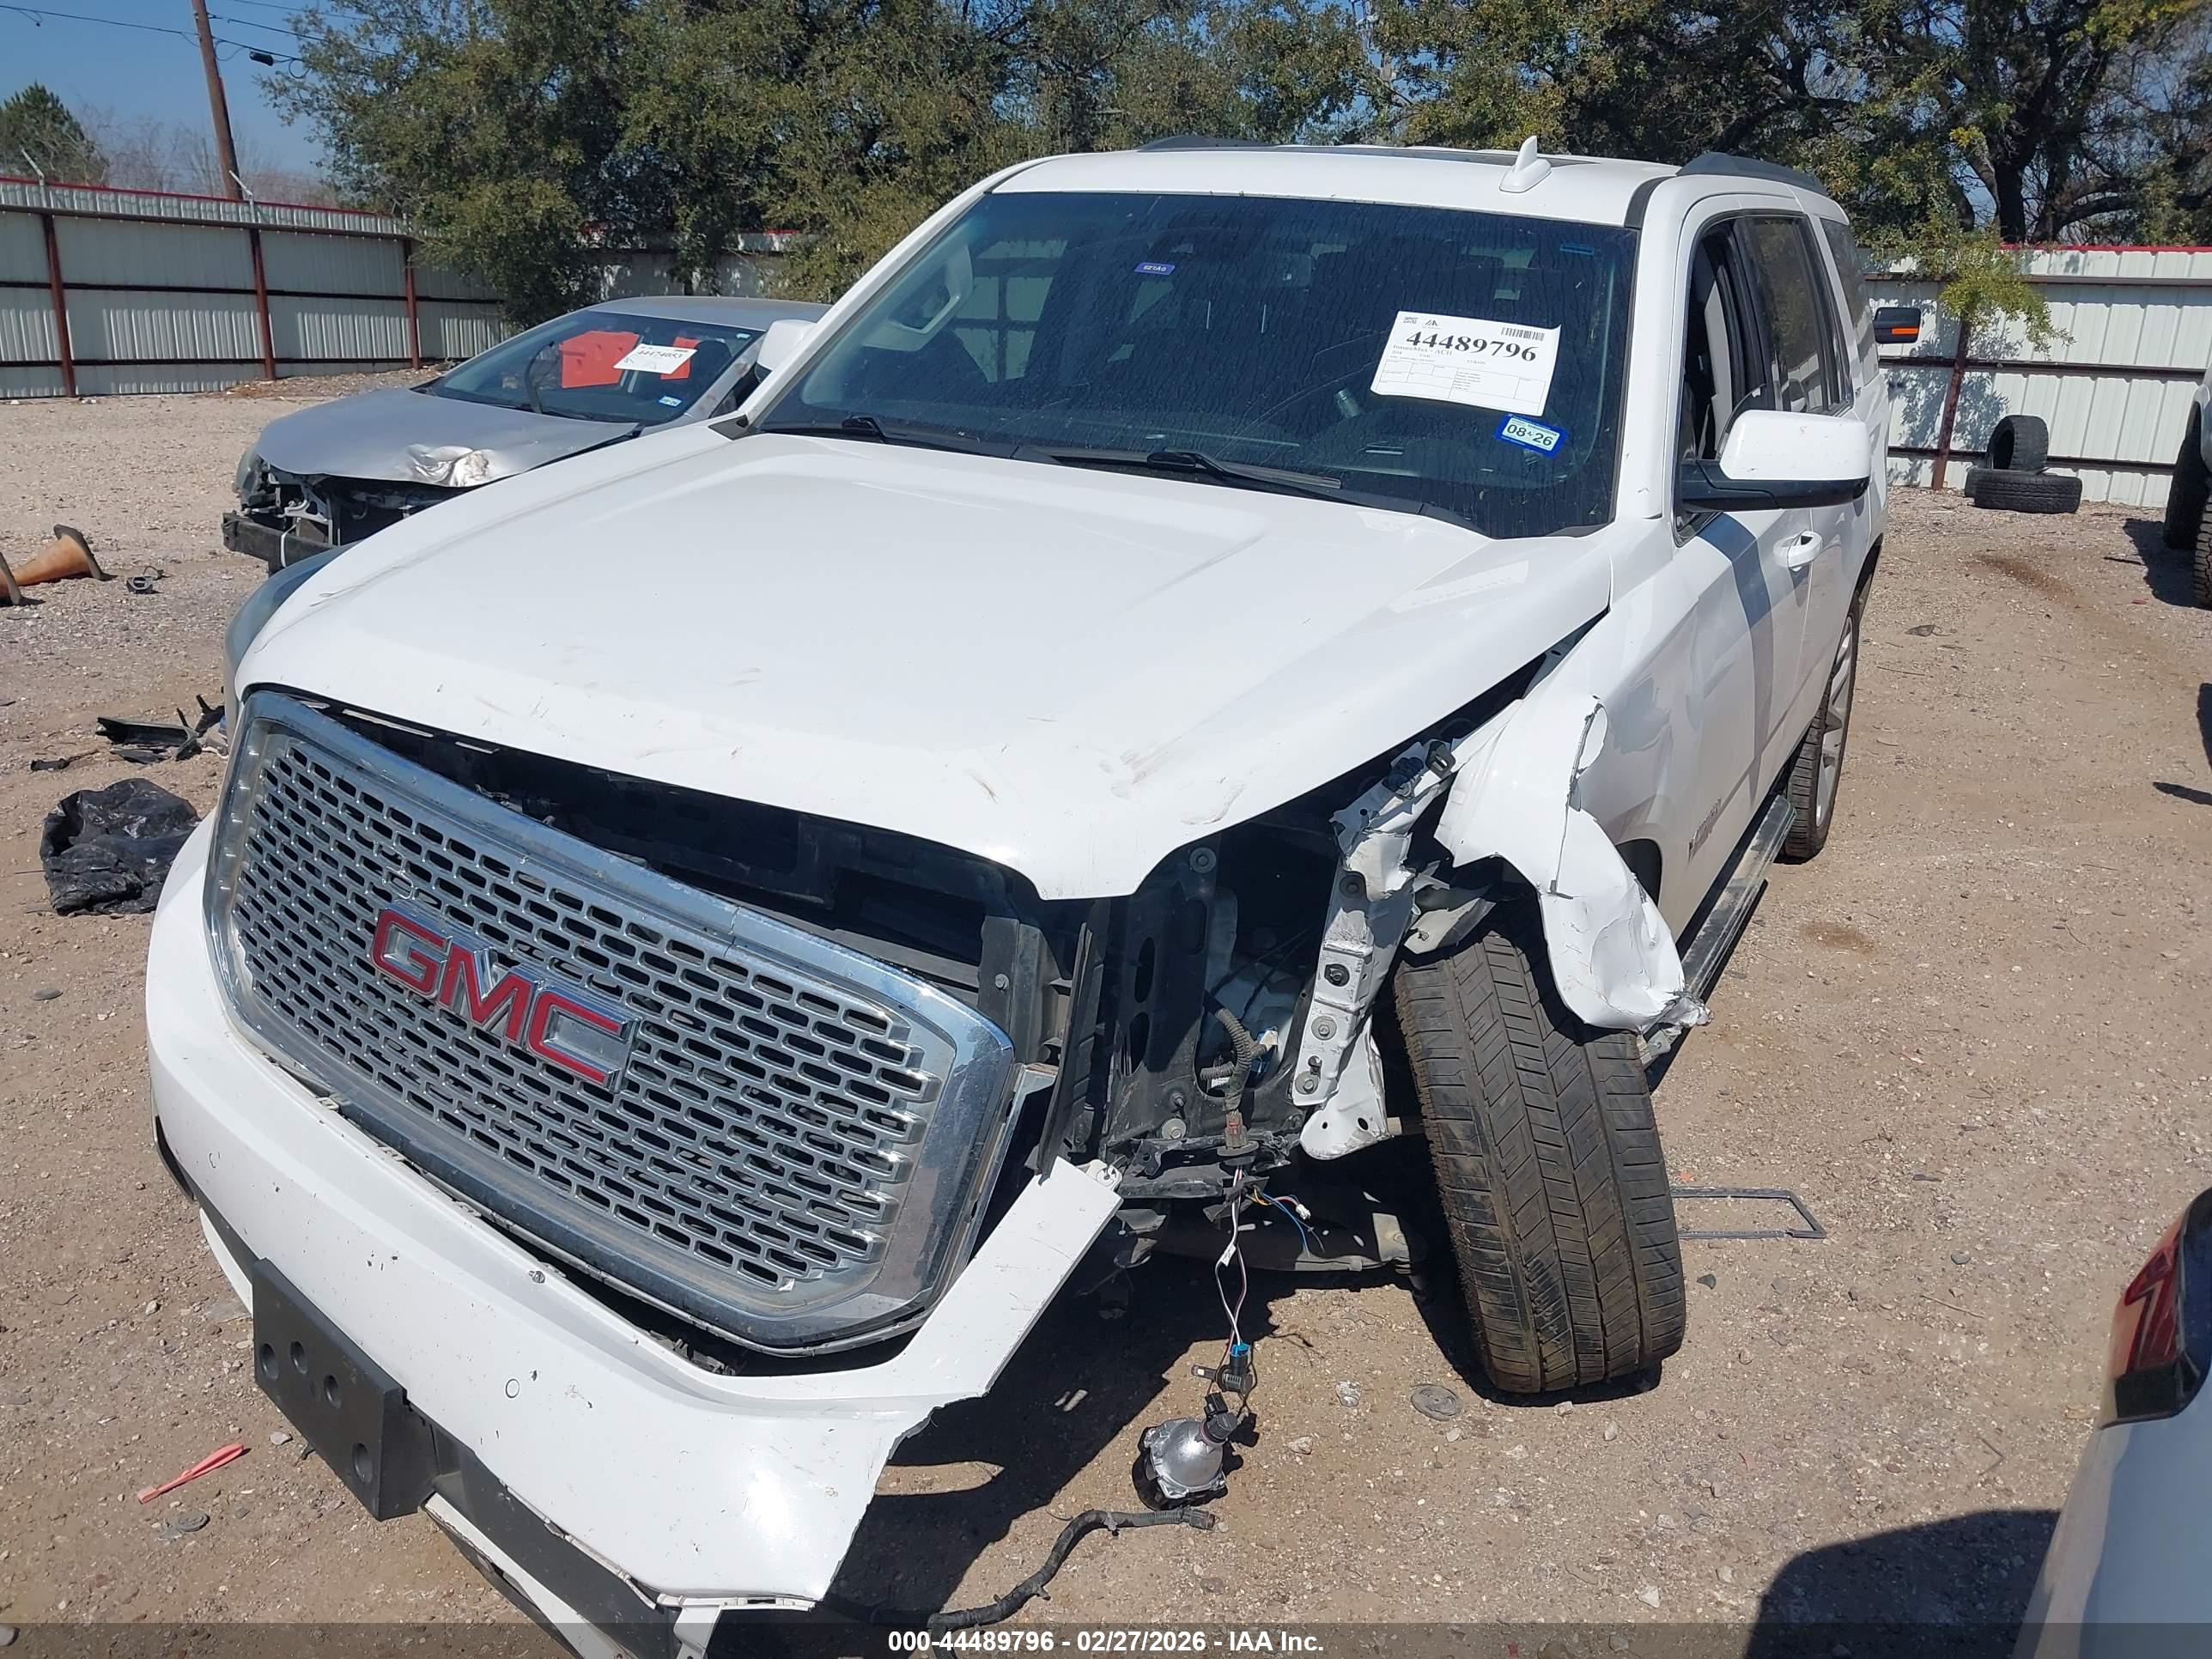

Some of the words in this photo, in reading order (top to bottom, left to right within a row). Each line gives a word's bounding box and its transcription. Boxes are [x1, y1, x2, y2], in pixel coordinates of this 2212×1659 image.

[1406, 331, 1540, 362] 44489796
[1507, 424, 1527, 437] 08
[1532, 432, 1553, 446] 26
[371, 902, 639, 1091] GMC
